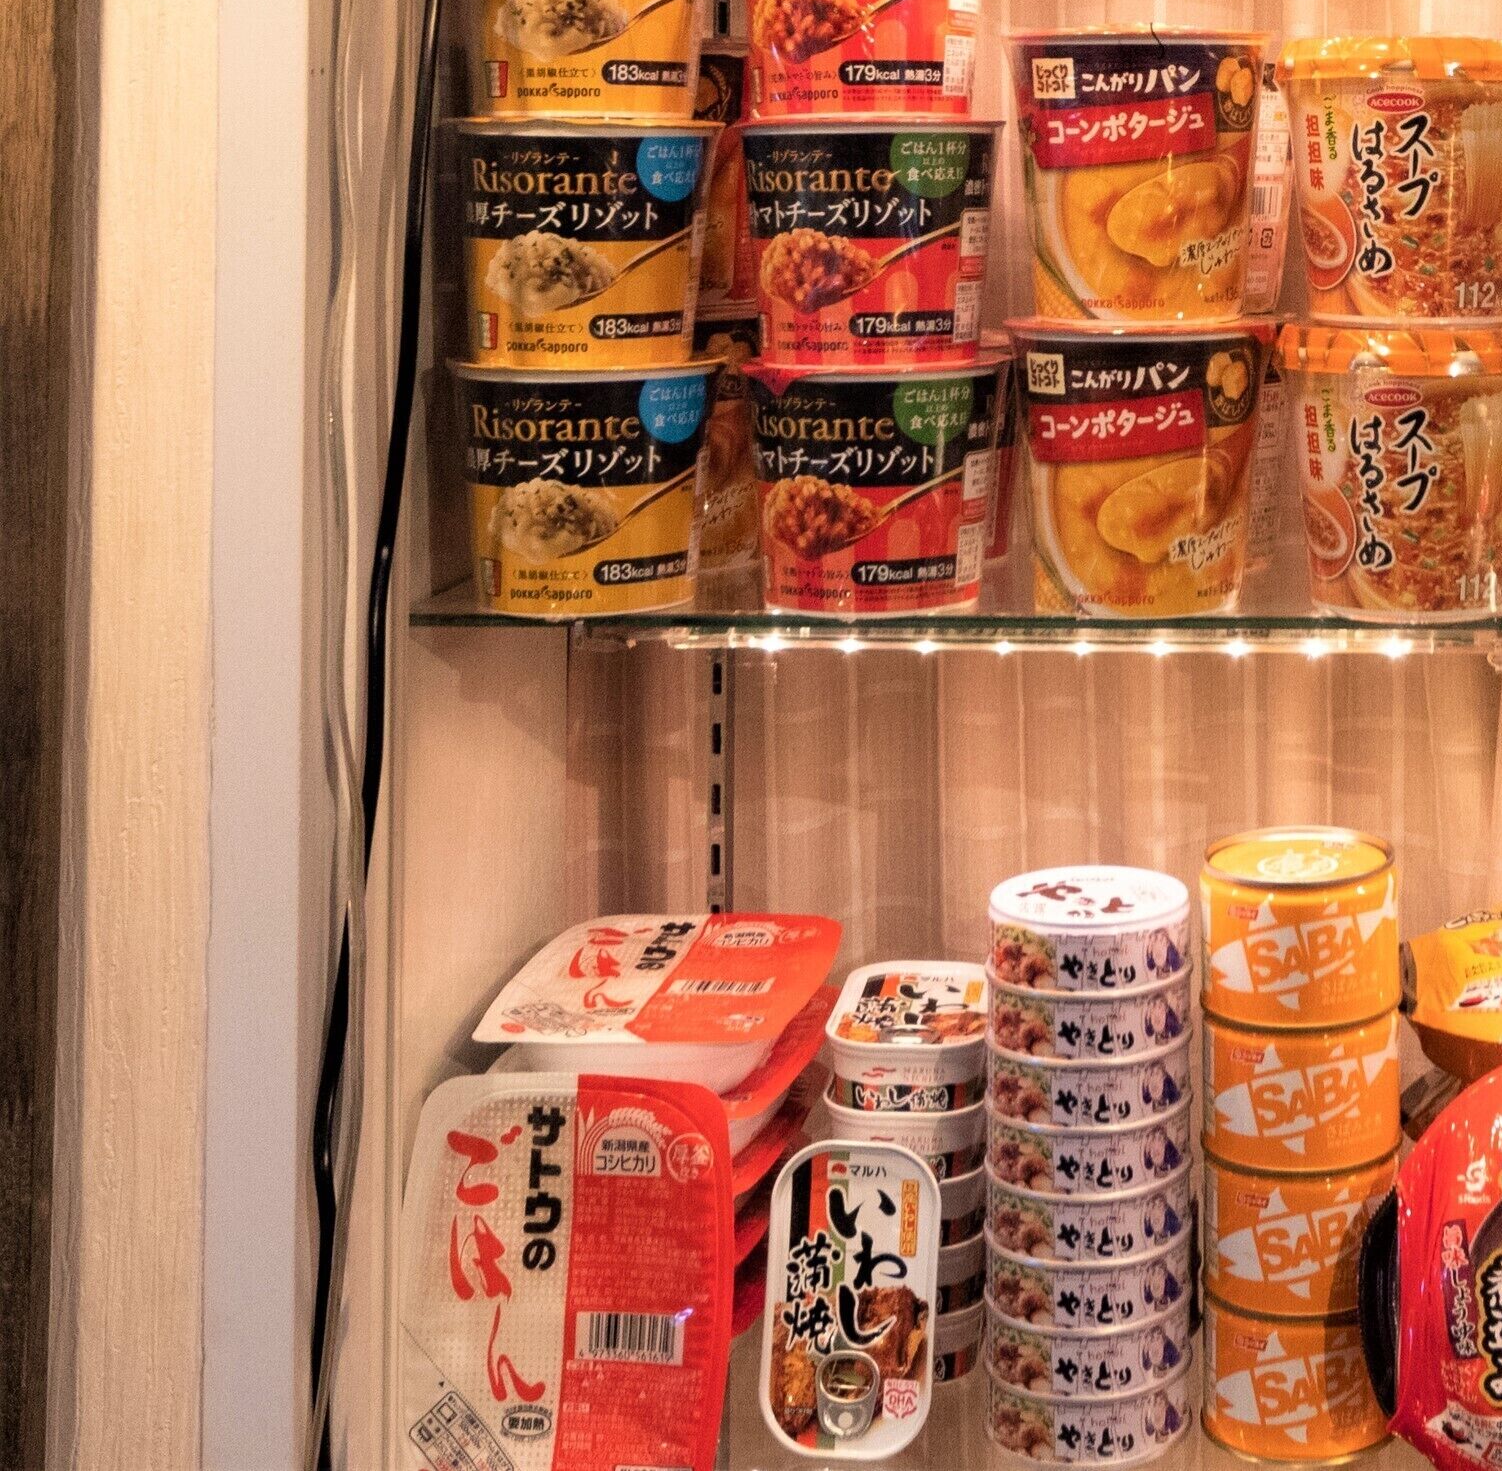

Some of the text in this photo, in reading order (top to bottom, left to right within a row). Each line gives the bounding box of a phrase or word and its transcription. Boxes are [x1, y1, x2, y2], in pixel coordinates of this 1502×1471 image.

[608, 65, 659, 83] 183kcal
[845, 64, 901, 83] 179kcal
[1081, 64, 1201, 94] こんがりパン
[1046, 105, 1206, 145] コーンポタージュ
[472, 157, 638, 196] Risorante
[1395, 112, 1439, 218] スープ
[1351, 119, 1394, 275] はるさめ
[1070, 361, 1190, 391] こんがりパン
[472, 404, 640, 442] Risorante
[1039, 402, 1196, 440] コーンポタージュ
[1395, 409, 1439, 513] スープ
[1350, 415, 1394, 569] はるさめ
[600, 563, 655, 583] 183kcal
[1252, 923, 1362, 980] SABA
[1254, 1066, 1366, 1125] SABA
[596, 1154, 657, 1174] コシヒカリ
[600, 1138, 651, 1154] 新潟県産
[521, 1105, 567, 1272] サトウの
[849, 1165, 888, 1178] マルハ
[446, 1123, 547, 1404] ごはん
[828, 1185, 909, 1348] いわし
[888, 1395, 914, 1409] DHA
